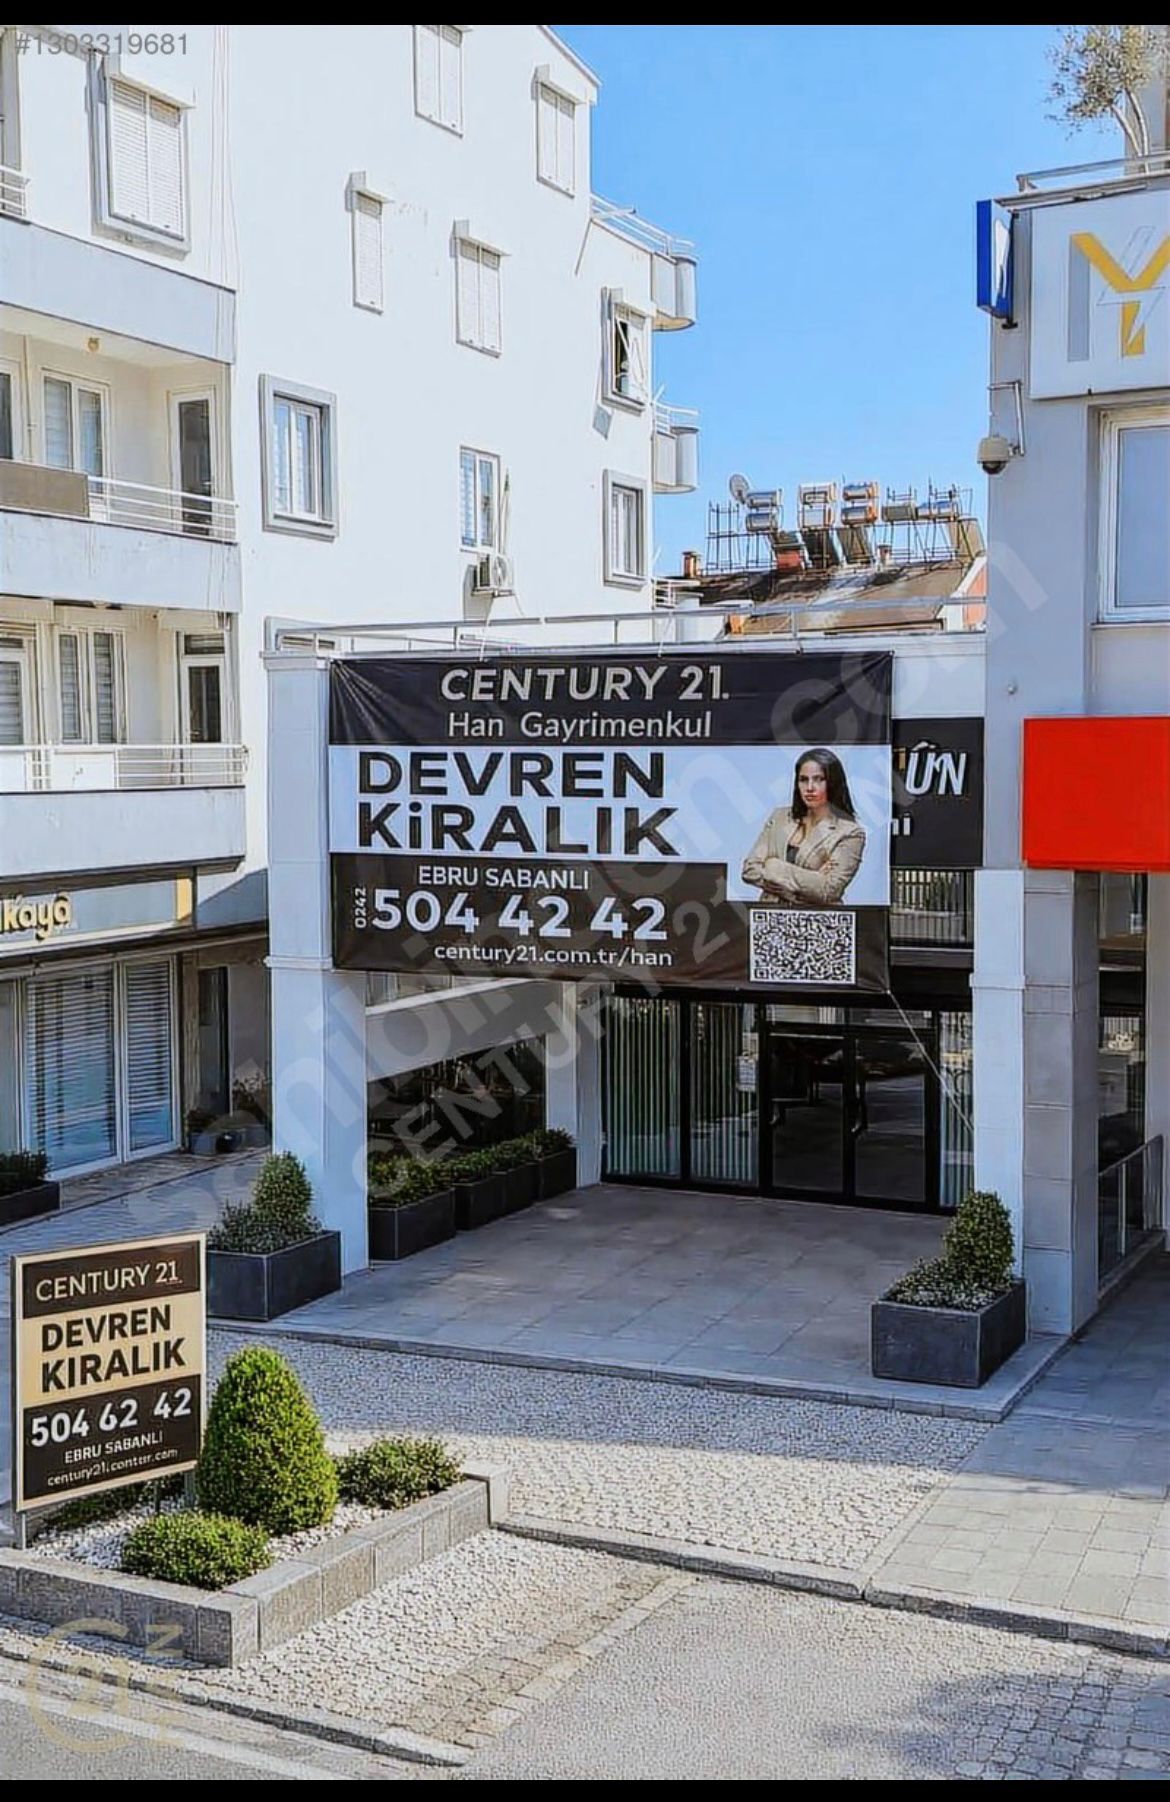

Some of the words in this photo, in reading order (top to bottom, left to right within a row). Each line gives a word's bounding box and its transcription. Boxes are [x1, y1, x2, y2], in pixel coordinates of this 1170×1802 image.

[441, 665, 668, 701] CENTURY
[449, 712, 504, 737] Han
[520, 710, 712, 744] Gayrimenkul
[358, 751, 665, 798] DEVREN
[418, 865, 479, 886] EBRU
[485, 869, 590, 891] SABANLI
[372, 889, 480, 934] 504
[498, 895, 572, 938] 42
[589, 898, 668, 941] 42
[434, 943, 673, 967] century21.com.tr/han
[36, 1265, 151, 1302] CENTURY
[42, 1304, 171, 1353] DEVREN
[42, 1338, 186, 1393] KIRALIK
[31, 1409, 90, 1448] 504
[99, 1399, 138, 1432] 62
[154, 1387, 192, 1419] 42
[65, 1445, 102, 1464] EBRU
